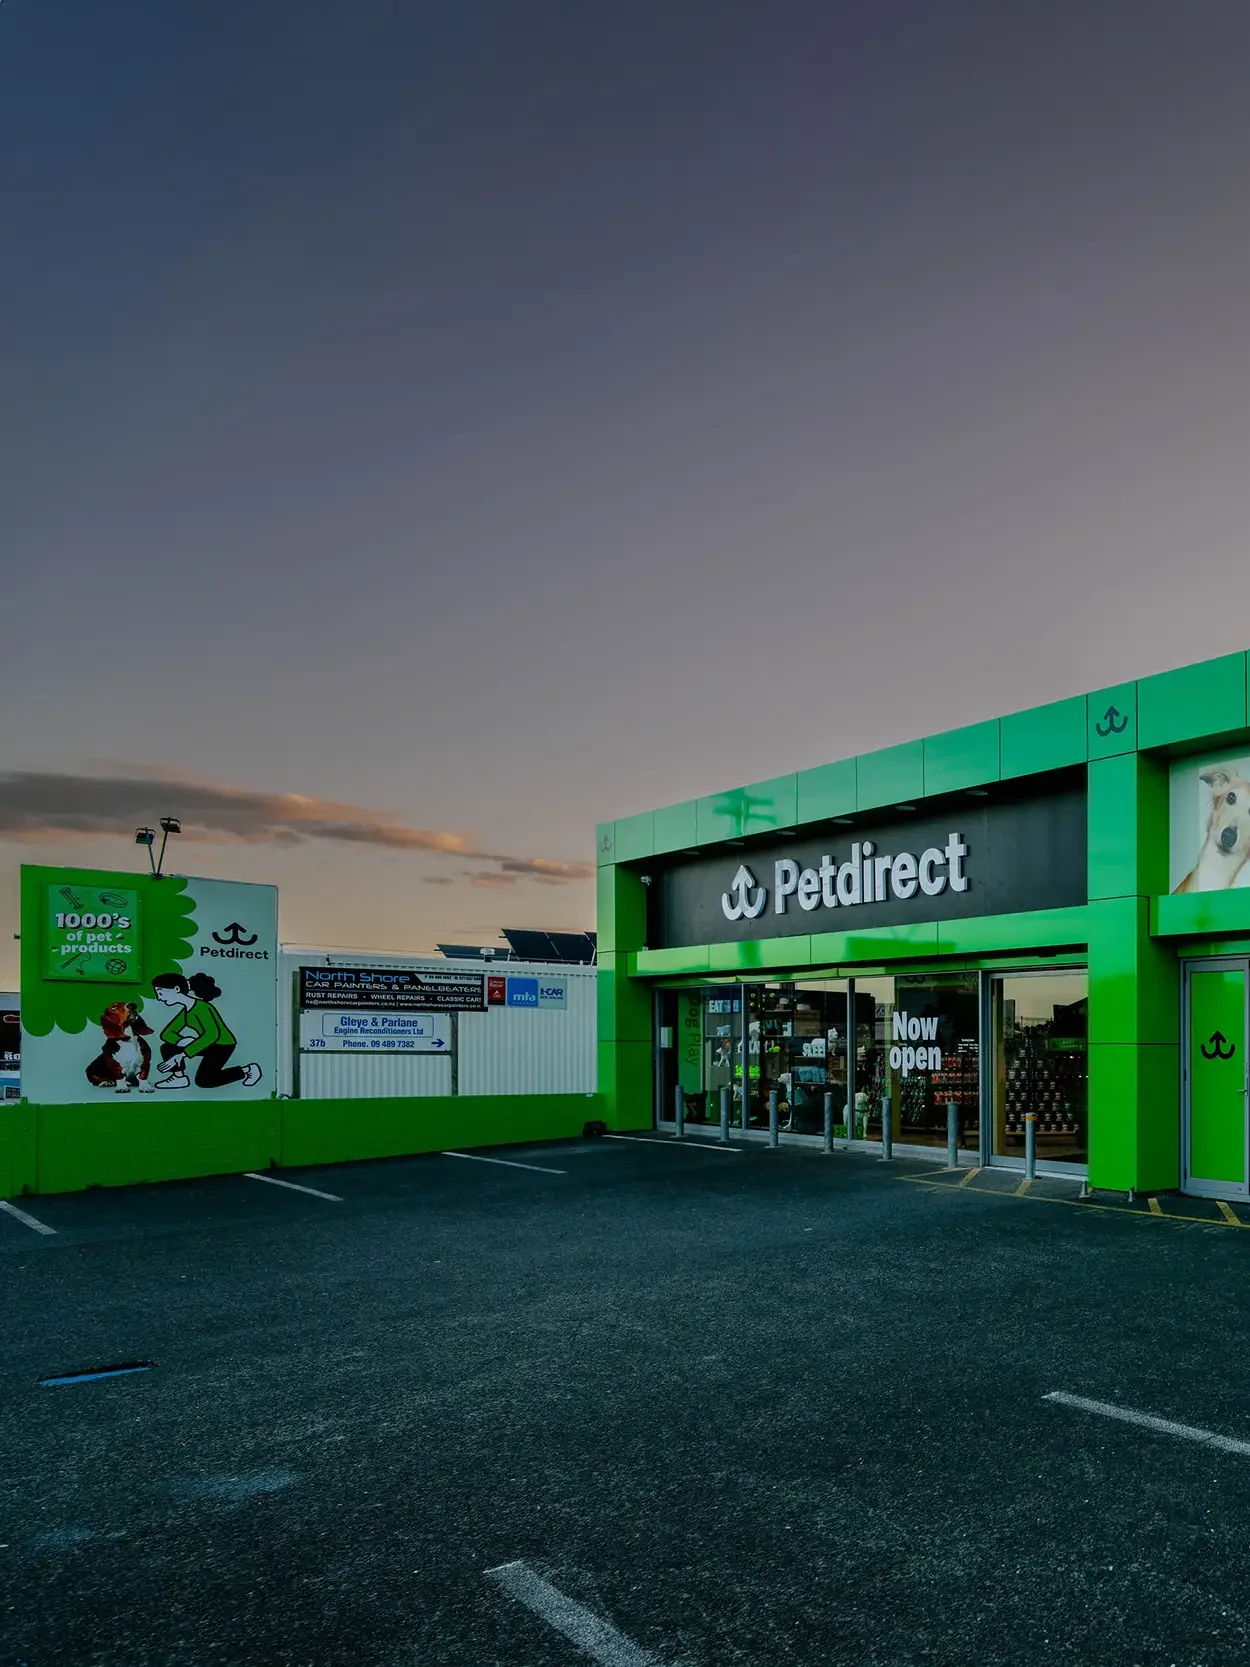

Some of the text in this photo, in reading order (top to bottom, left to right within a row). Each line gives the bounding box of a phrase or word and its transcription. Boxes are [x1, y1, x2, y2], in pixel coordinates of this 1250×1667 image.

[775, 832, 968, 914] Petdirect
[55, 912, 131, 929] 1000's
[66, 930, 112, 943] of pet
[61, 942, 132, 955] products
[200, 946, 269, 960] Petdirect
[305, 969, 410, 983] North Shore
[334, 982, 388, 990] PAINTERS
[403, 984, 482, 993] PANELBEATERS
[513, 991, 536, 1002] mta
[340, 1016, 418, 1028] Gleye & Parlane
[892, 1011, 939, 1041] Now
[334, 1026, 359, 1035] Engine
[360, 1027, 412, 1035] Reconditioners
[309, 1039, 415, 1048] 37b Phone. 09 489 7382
[889, 1045, 942, 1077] open
